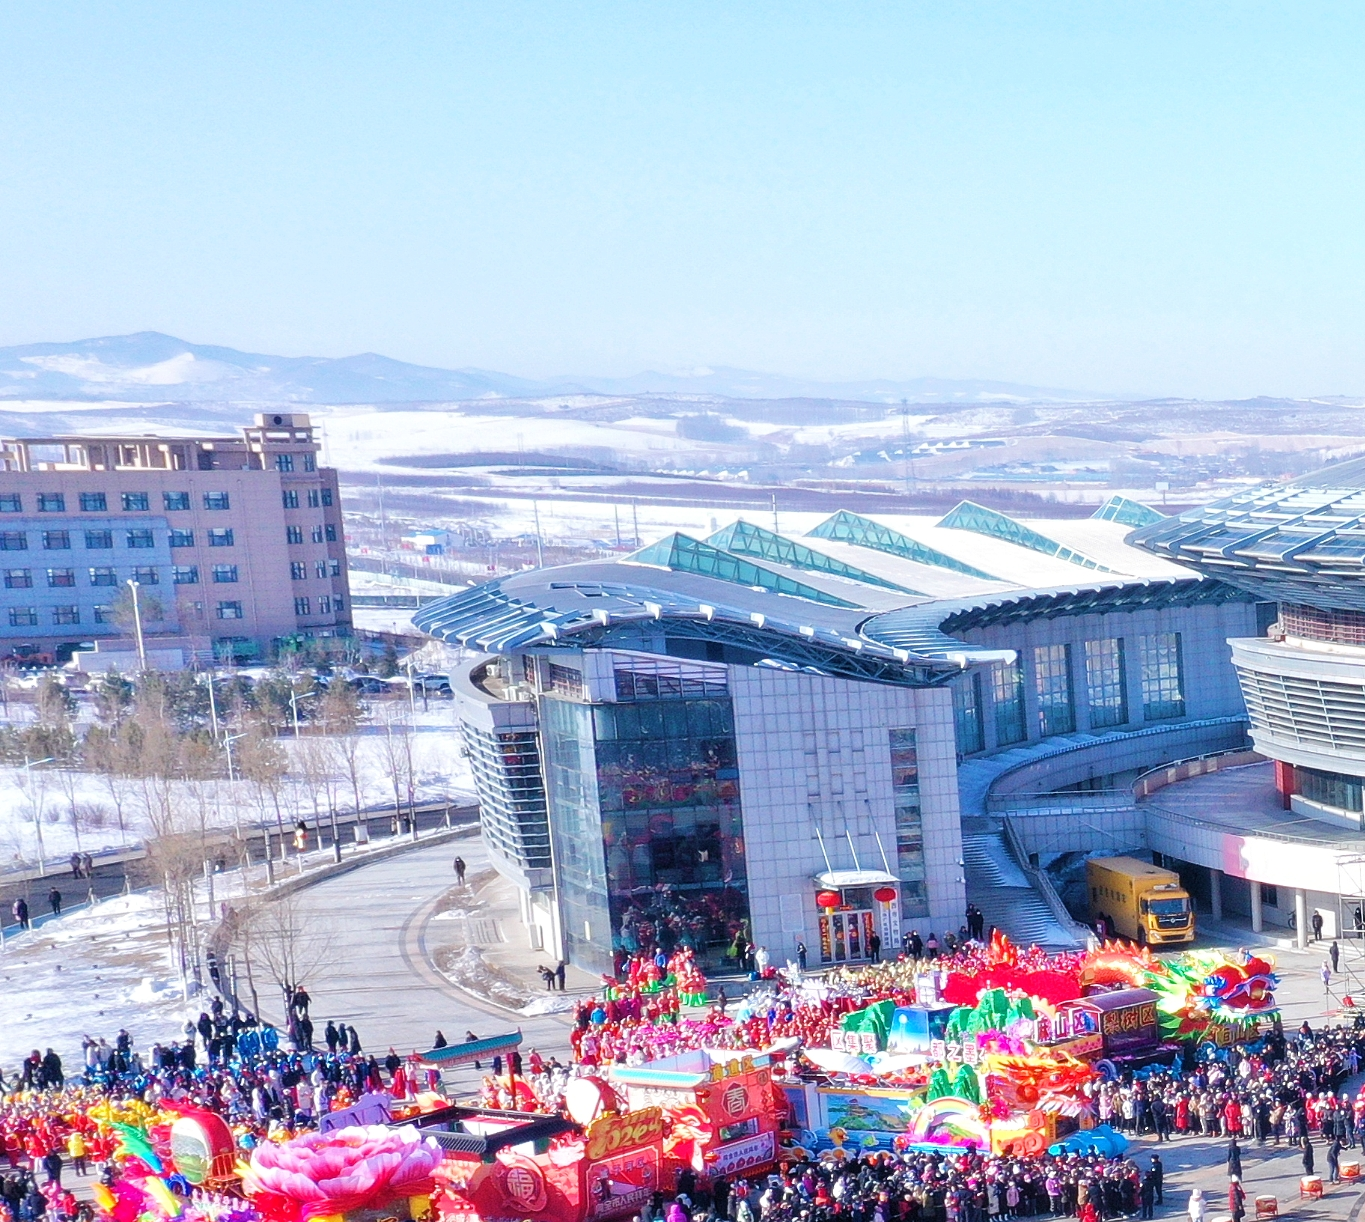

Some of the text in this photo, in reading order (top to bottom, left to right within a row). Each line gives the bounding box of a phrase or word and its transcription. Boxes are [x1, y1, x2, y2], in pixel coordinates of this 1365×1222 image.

[1102, 1005, 1157, 1036] 梨树区
[726, 1086, 746, 1115] 春
